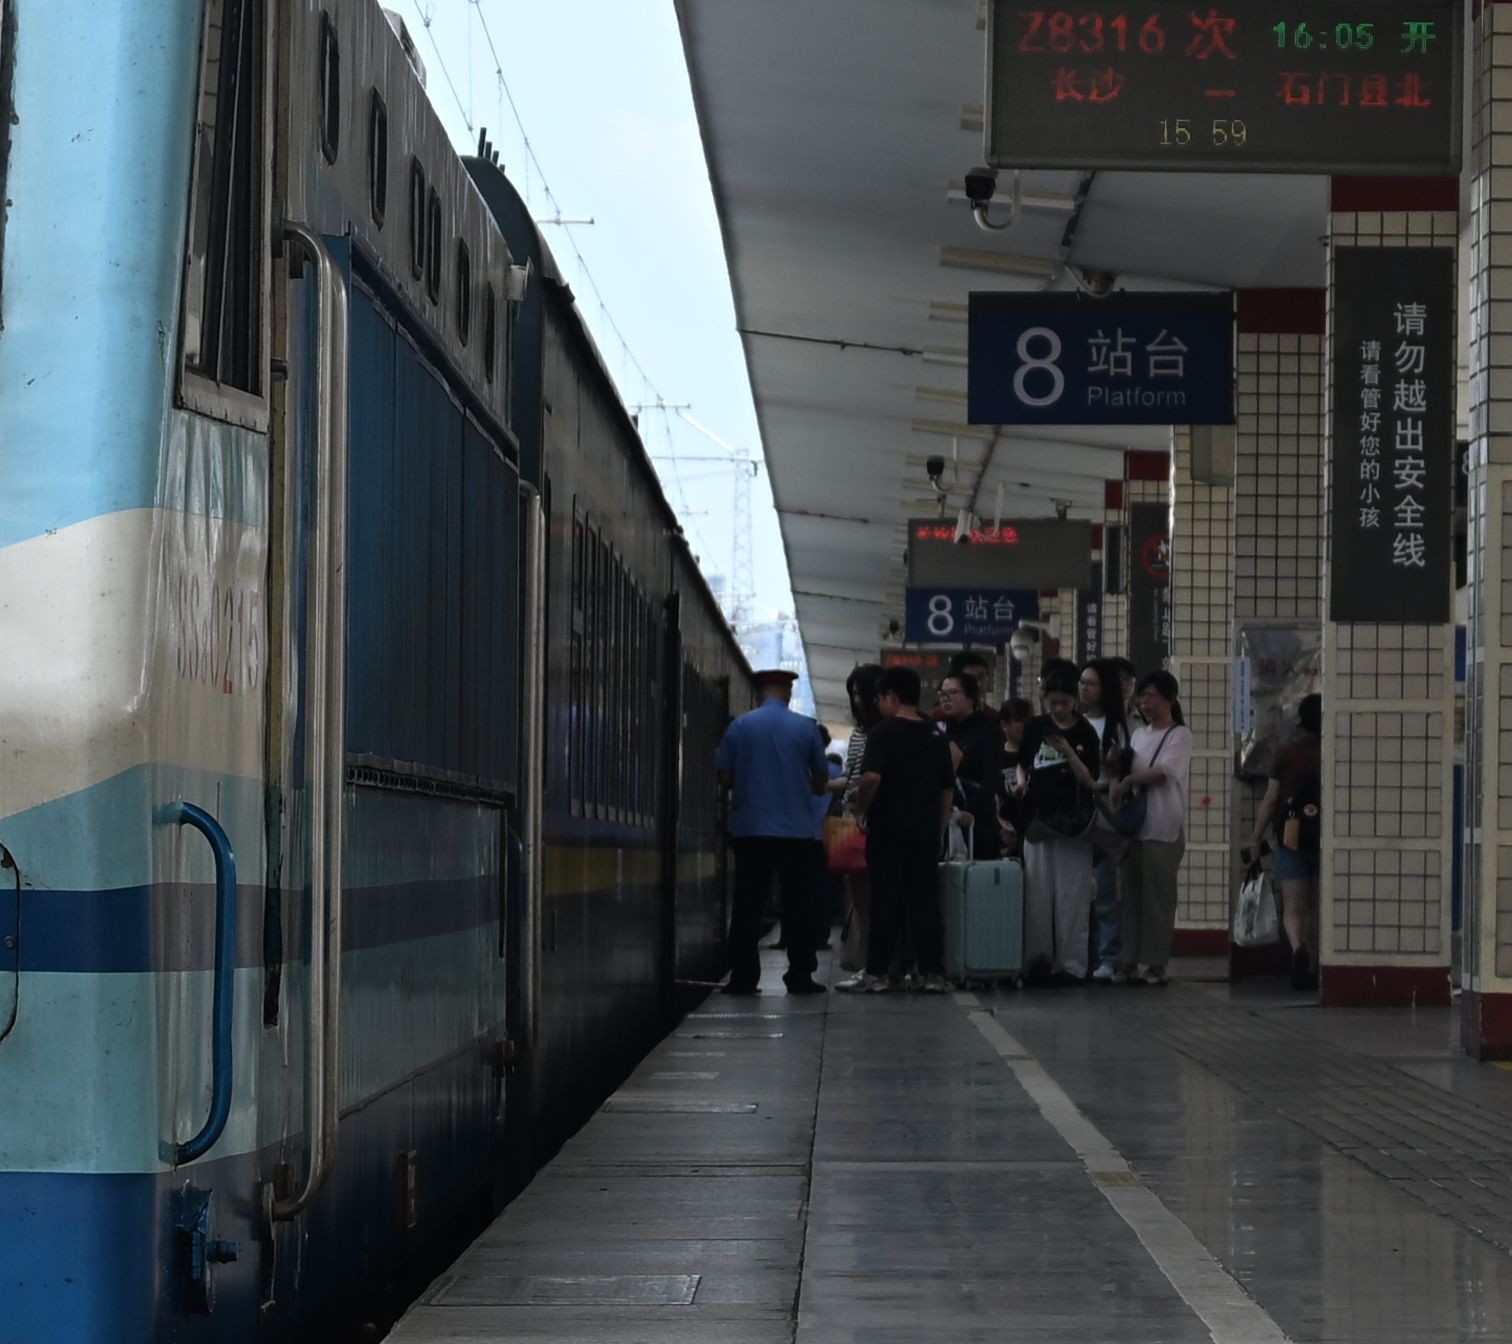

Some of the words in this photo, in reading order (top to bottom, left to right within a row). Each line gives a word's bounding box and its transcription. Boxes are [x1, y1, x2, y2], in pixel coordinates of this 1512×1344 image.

[1018, 10, 1166, 54] Z8316
[1185, 8, 1237, 59] 次
[1273, 21, 1374, 50] 16:05
[1400, 21, 1436, 54] 开
[1051, 66, 1125, 103] 长沙
[1278, 69, 1431, 107] 石门县北
[1012, 326, 1065, 408] 8
[1086, 327, 1189, 378] 站台
[1087, 384, 1187, 408] Platform
[1360, 339, 1381, 528] 请看管好您的小孩
[1392, 302, 1427, 567] 请勿越出安全线
[927, 594, 954, 636] 8
[964, 594, 1015, 621] 站台
